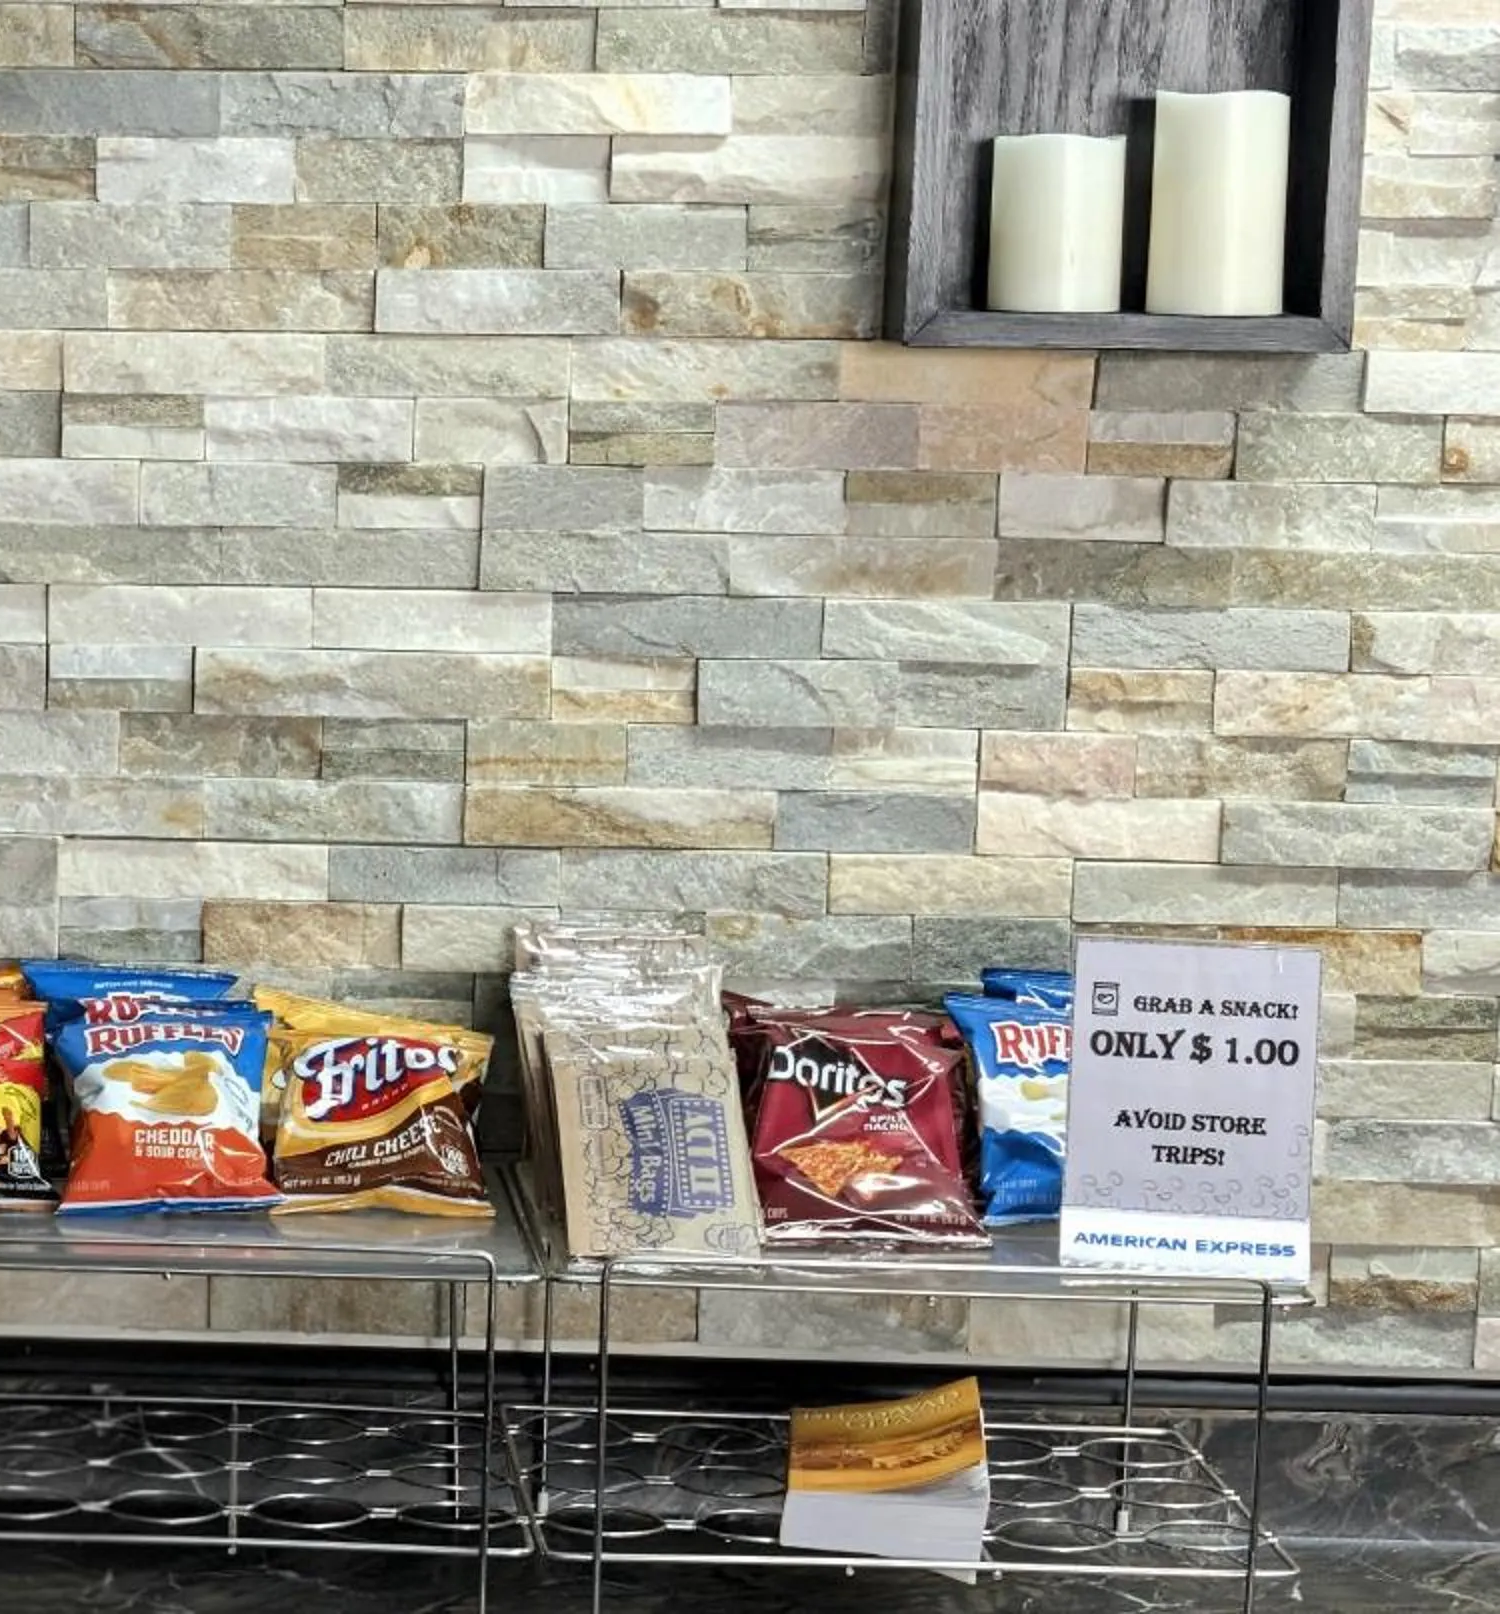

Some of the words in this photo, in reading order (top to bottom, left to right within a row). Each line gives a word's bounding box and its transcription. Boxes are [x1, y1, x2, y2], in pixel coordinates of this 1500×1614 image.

[1133, 995, 1193, 1015] GRAB
[1198, 1000, 1216, 1016] A
[1220, 1000, 1299, 1021] SNACK!
[1089, 1028, 1187, 1060] ONLY
[1190, 1032, 1213, 1065] $
[1225, 1037, 1300, 1067] 1.00
[767, 1046, 907, 1108] Doritos
[631, 1104, 661, 1150] Mini
[1113, 1108, 1187, 1131] AVOID
[1191, 1115, 1268, 1137] STORE
[134, 1128, 215, 1149] CHEDDAR
[145, 1146, 175, 1158] SOUR
[323, 1146, 367, 1168] CHILI
[1151, 1144, 1226, 1167] TRIPS!
[635, 1154, 663, 1203] Bags
[1073, 1231, 1188, 1252] AMERICAN
[1195, 1239, 1297, 1258] EXPRESS
